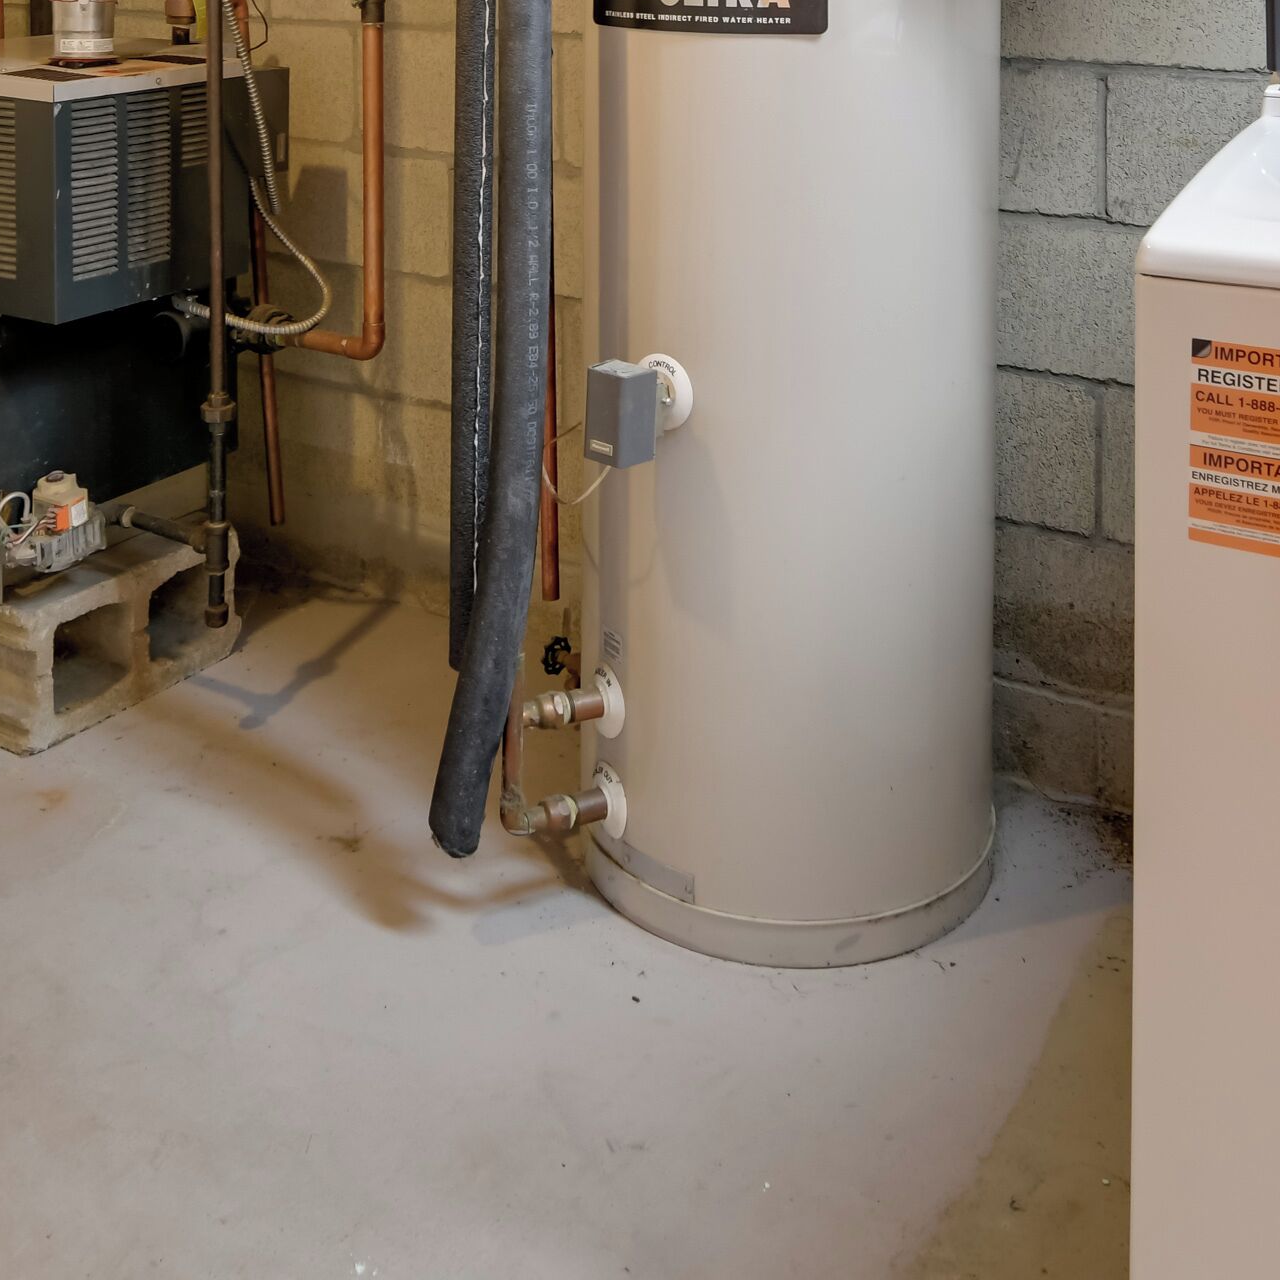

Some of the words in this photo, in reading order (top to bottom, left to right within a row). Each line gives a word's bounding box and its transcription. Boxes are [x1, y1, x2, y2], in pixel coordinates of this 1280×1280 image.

[605, 10, 634, 19] STAINLESS
[636, 12, 656, 20] STEEL
[658, 13, 692, 22] INDIRECT
[695, 15, 719, 23] FIRED
[722, 16, 753, 24] WATER
[756, 16, 791, 24] HEATER
[648, 360, 677, 377] CONTROL
[1195, 390, 1233, 406] CALL
[1197, 407, 1213, 416] YOU
[1215, 410, 1236, 420] MUST
[1238, 414, 1278, 425] REGISTER
[1191, 471, 1269, 493] ENREGISTREZ
[1193, 487, 1243, 504] APPELEZ
[1246, 495, 1260, 507] LE
